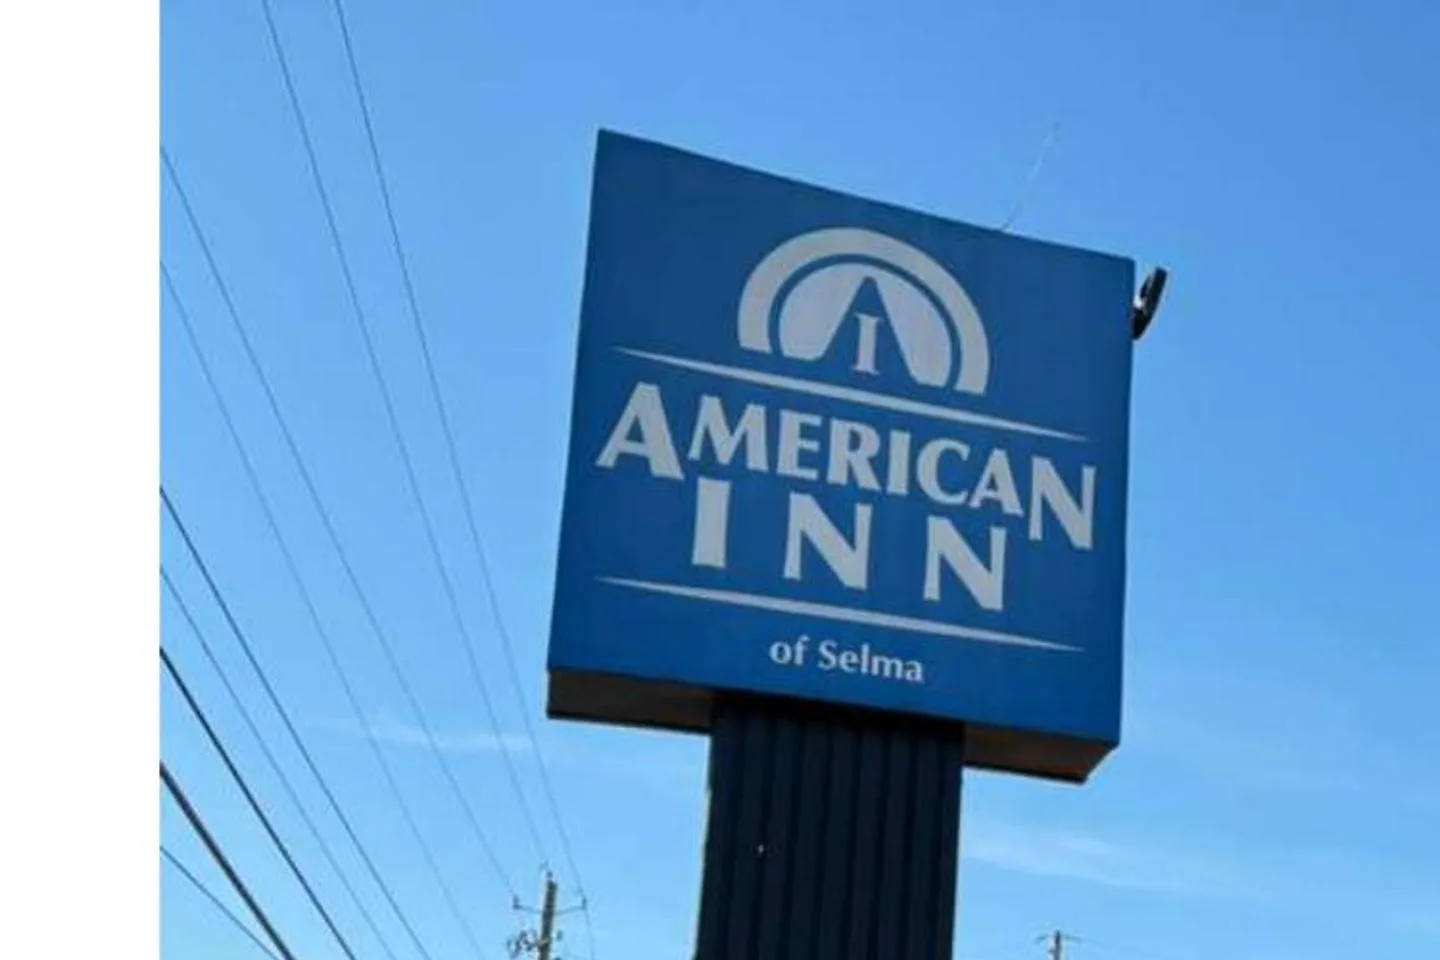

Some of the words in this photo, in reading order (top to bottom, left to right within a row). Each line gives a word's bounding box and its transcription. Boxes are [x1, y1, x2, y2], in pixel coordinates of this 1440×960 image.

[596, 380, 1096, 552] AMERICAN
[692, 476, 1008, 612] INN
[769, 634, 807, 667] of
[817, 640, 924, 683] Selma
